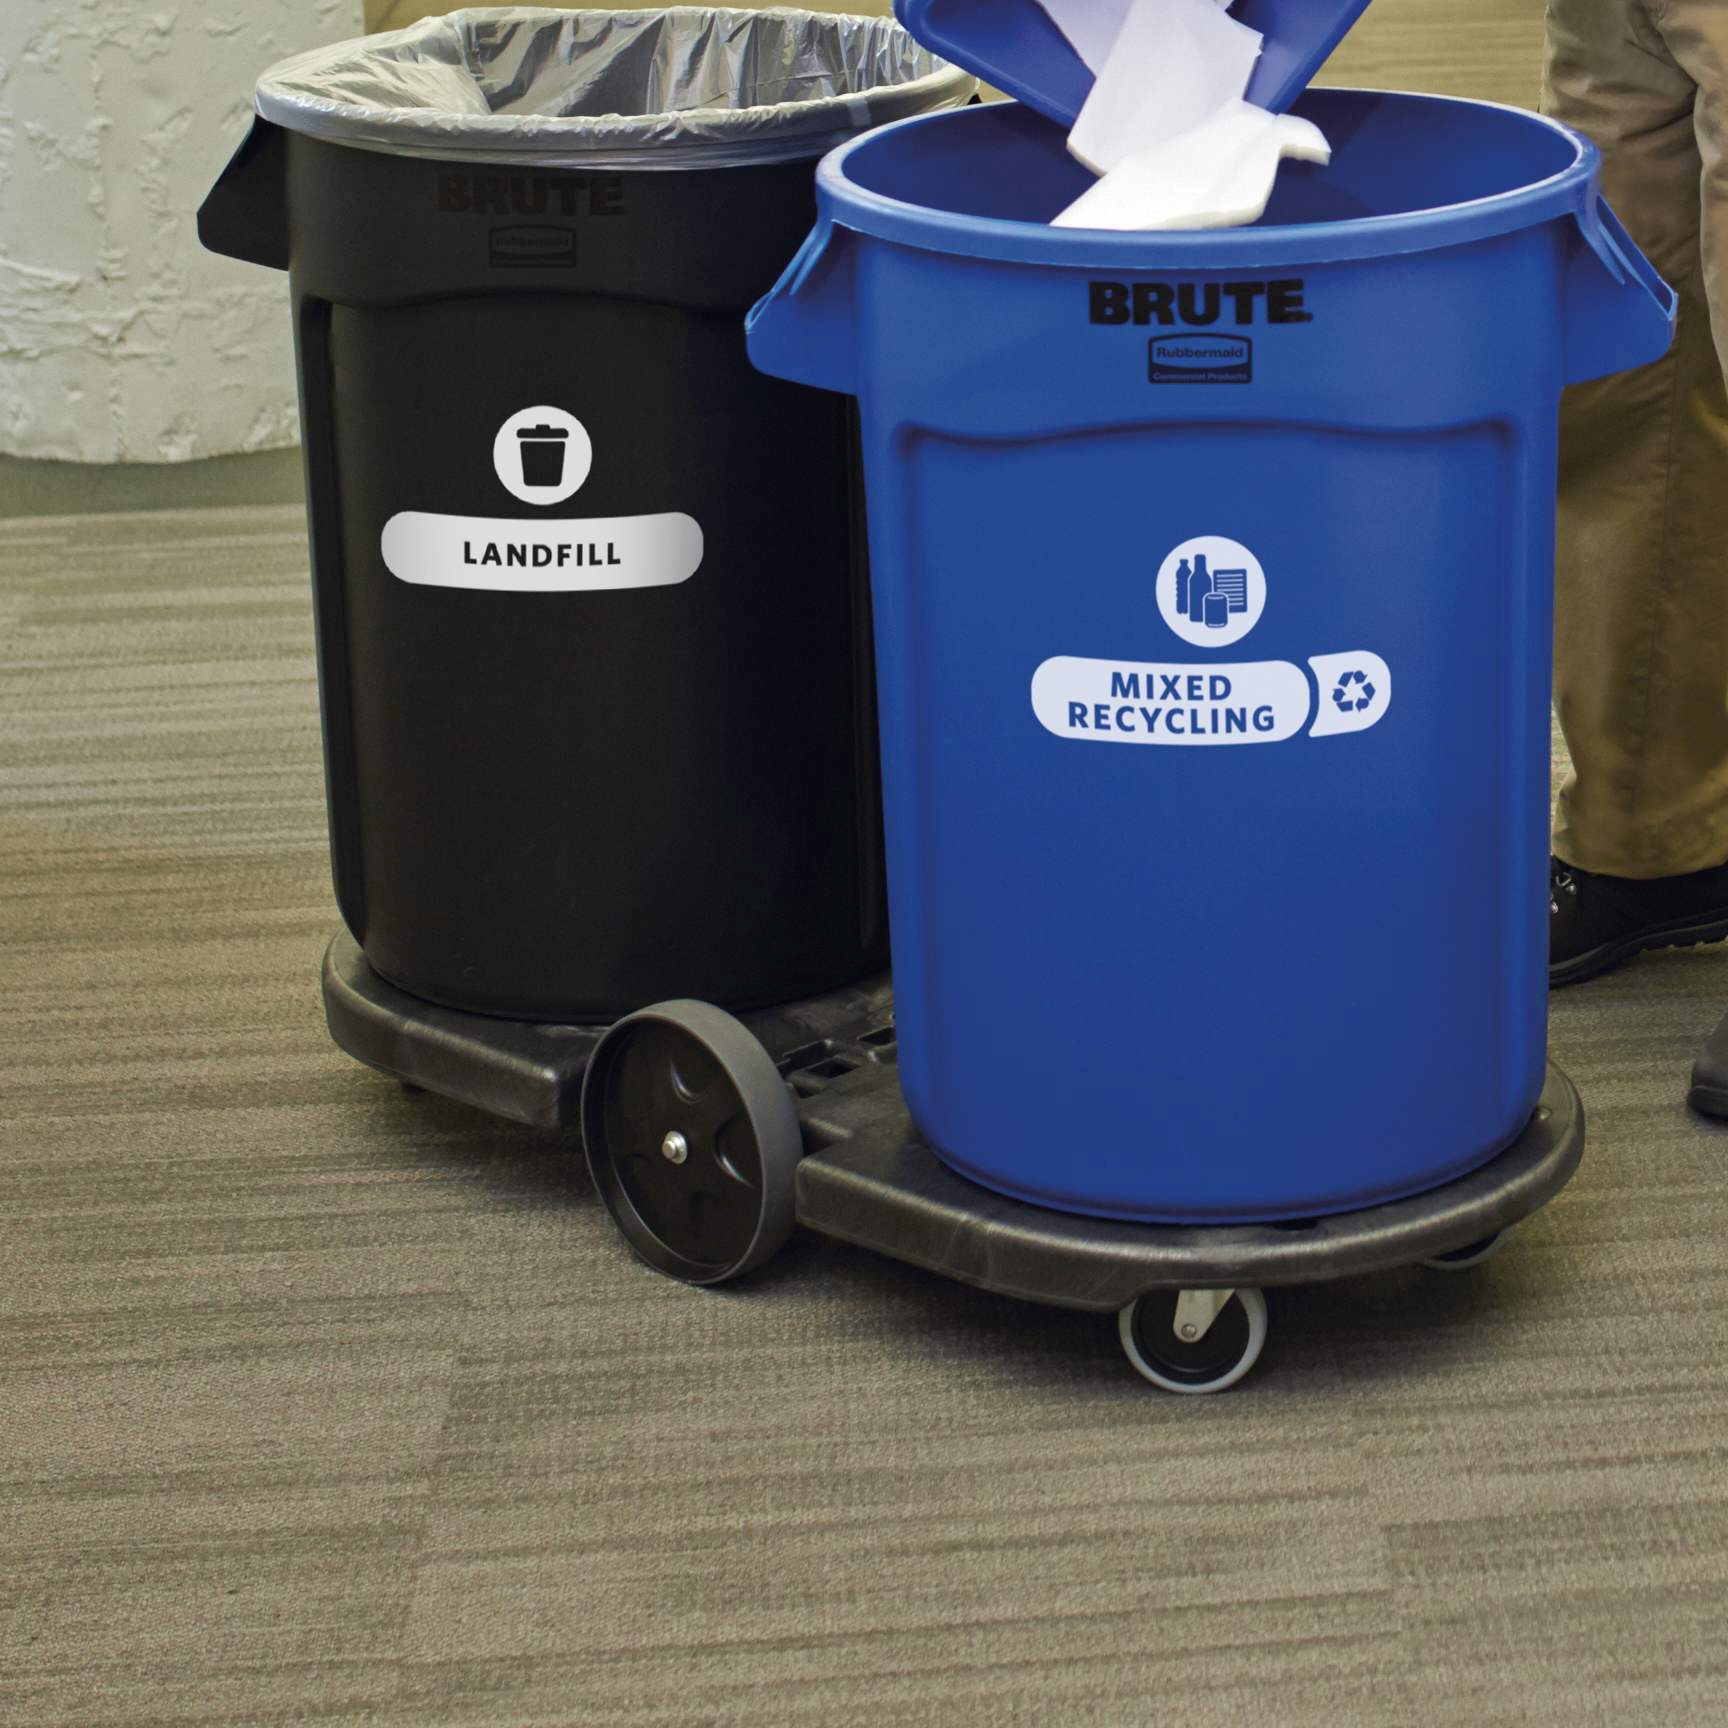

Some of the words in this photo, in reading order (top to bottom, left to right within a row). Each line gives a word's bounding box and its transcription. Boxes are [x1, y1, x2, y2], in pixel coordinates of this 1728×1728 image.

[439, 175, 624, 216] BRUTE
[1088, 279, 1306, 325] BRUTE
[1156, 345, 1245, 359] Rubbermaid
[463, 540, 622, 568] LANDFILL
[1110, 671, 1232, 702] MIXED
[1067, 701, 1276, 736] RECYCLING
